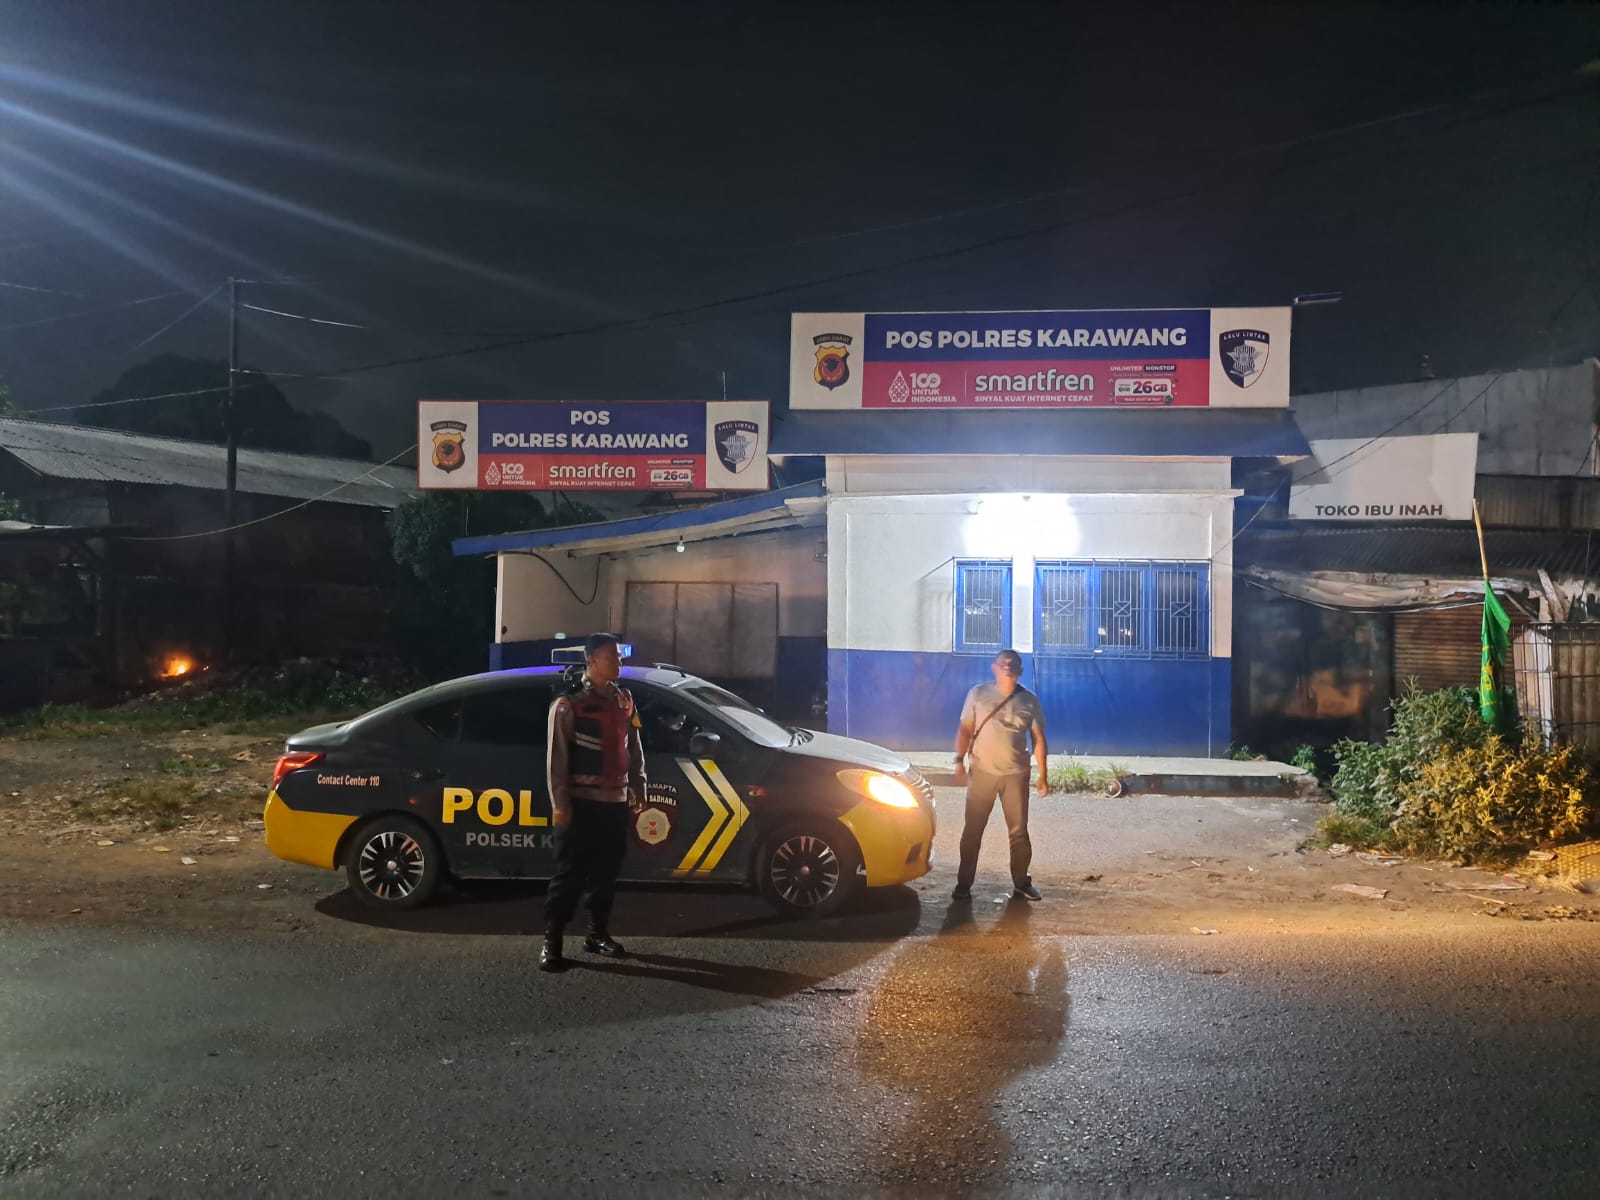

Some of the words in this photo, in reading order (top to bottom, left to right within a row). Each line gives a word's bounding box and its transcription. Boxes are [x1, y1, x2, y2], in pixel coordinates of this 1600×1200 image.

[886, 331, 933, 349] POS
[938, 330, 1032, 348] POLRES
[1037, 328, 1187, 347] KARAWANG
[975, 369, 1094, 391] smartfren
[571, 410, 610, 425] POS
[492, 432, 568, 448] POLRES
[571, 433, 689, 448] KARAWANG
[549, 462, 636, 478] smartfren
[1315, 505, 1360, 516] TOKO
[1365, 505, 1394, 516] IBU
[1399, 504, 1443, 515] INAH
[317, 774, 343, 786] Contact
[345, 775, 368, 787] Center
[369, 776, 380, 787] 110
[647, 783, 678, 794] AMAPTA
[442, 787, 556, 827] POL
[466, 832, 535, 848] POLSEK
